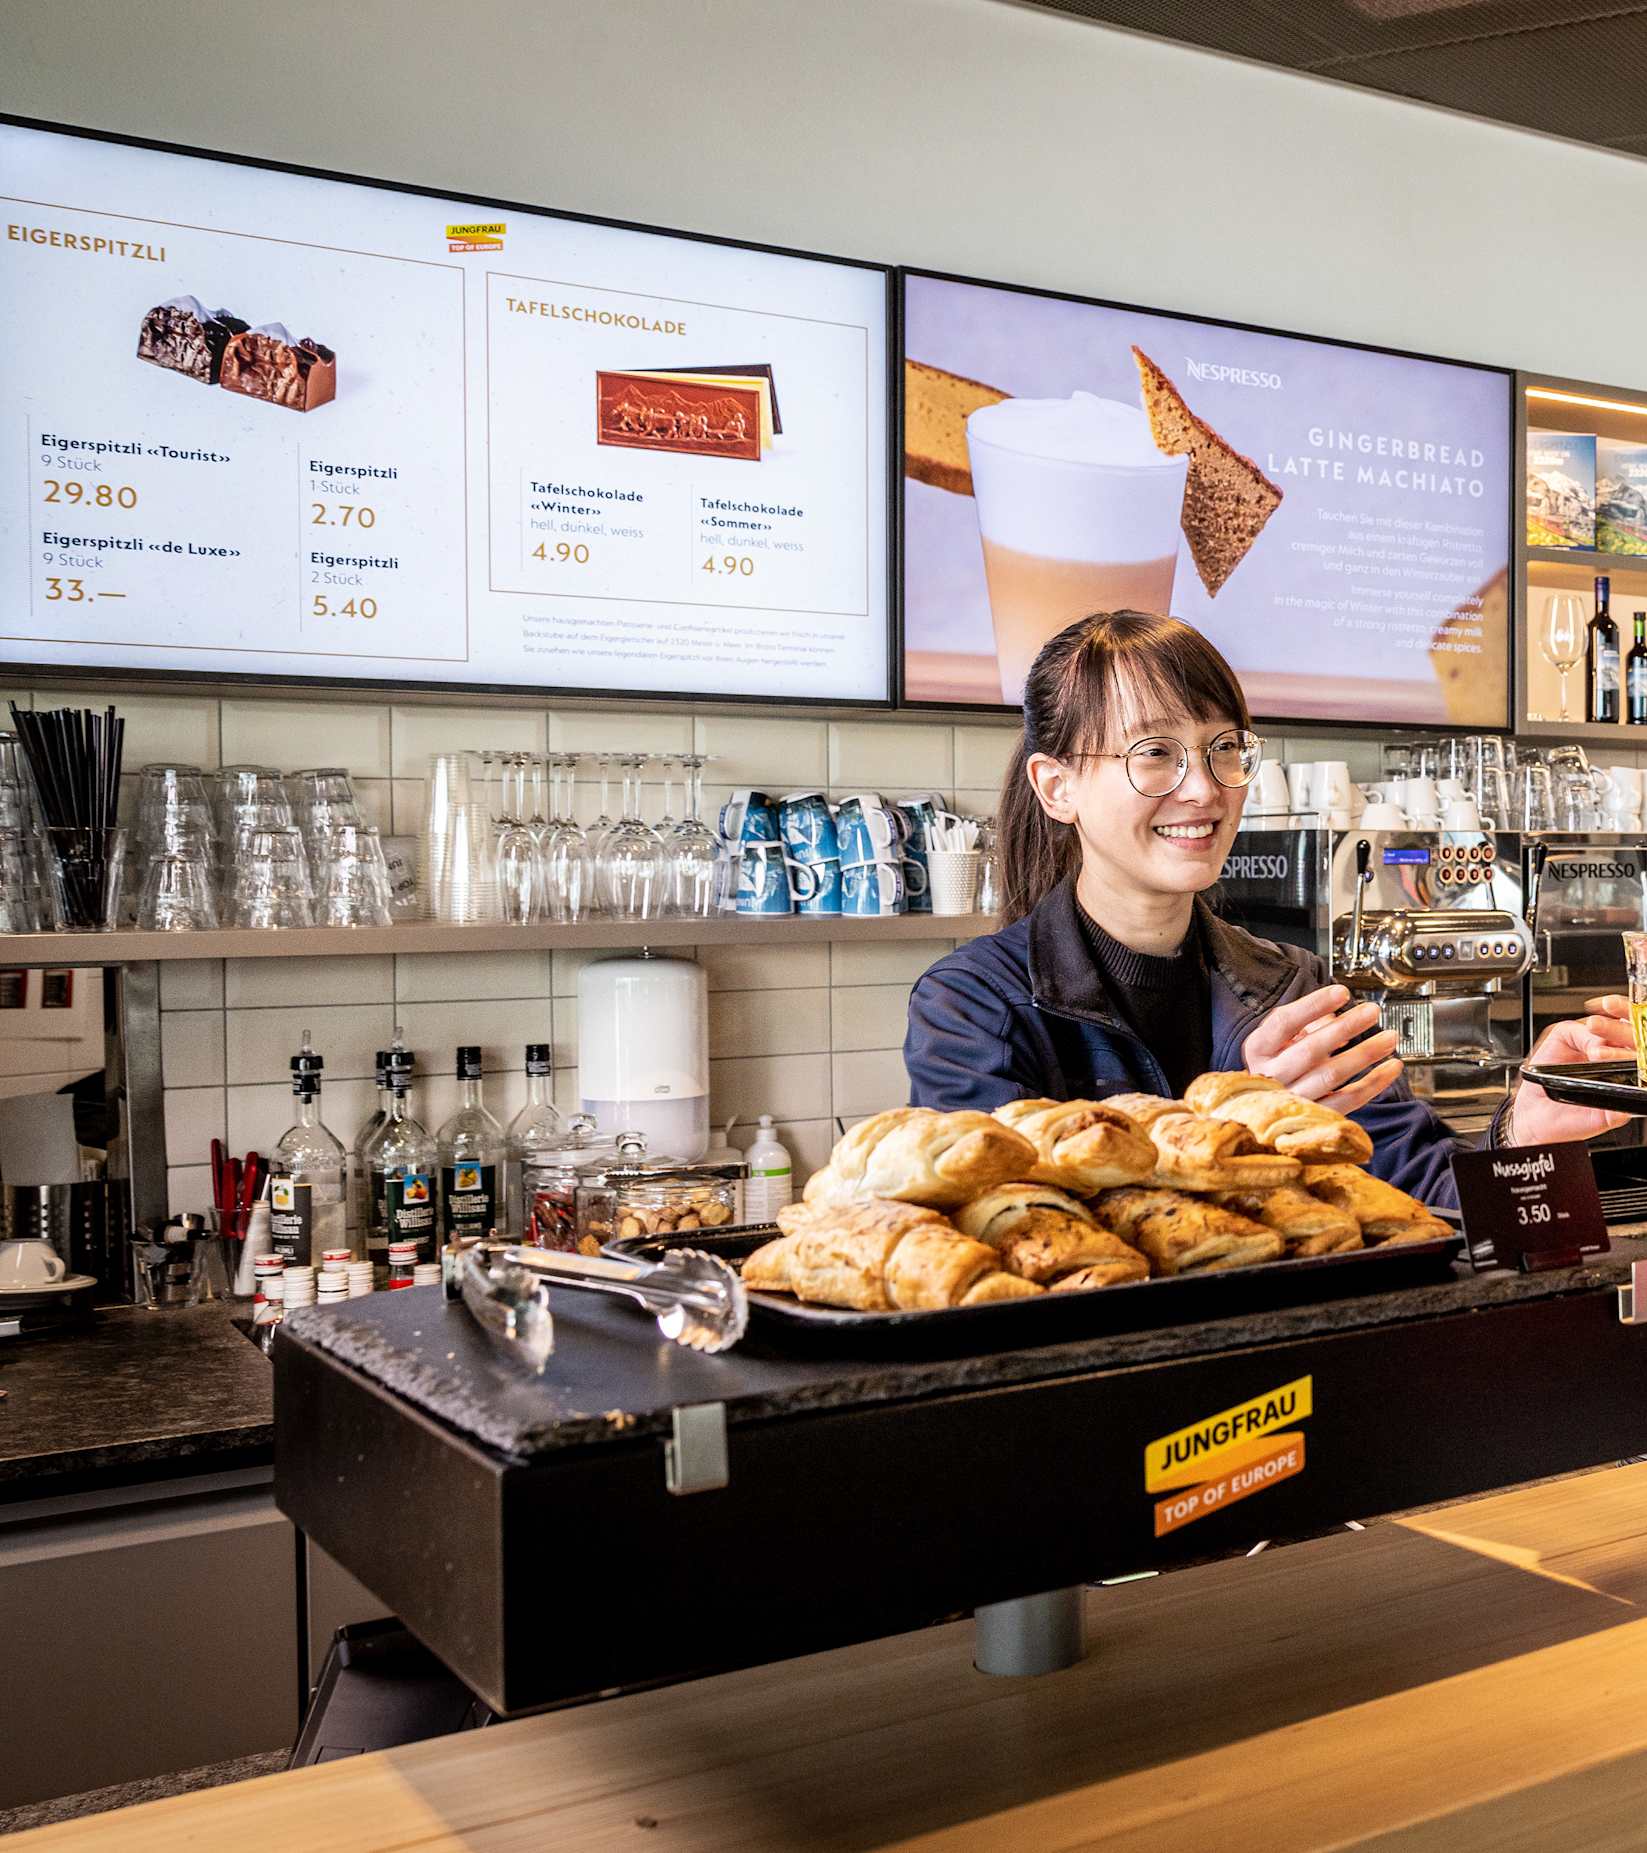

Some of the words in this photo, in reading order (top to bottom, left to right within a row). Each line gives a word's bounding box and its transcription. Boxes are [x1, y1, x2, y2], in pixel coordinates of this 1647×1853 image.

[451, 225, 501, 234] JUNGFRAU
[7, 224, 167, 263] EIGERSPITZLI
[506, 297, 687, 337] TAFELSCHOKOLADE
[1184, 357, 1281, 390] NESPRESSO
[41, 434, 142, 457] Eigerspitzli
[147, 444, 231, 463] «Tourist»
[1308, 427, 1485, 468] GINGERBREAD
[41, 454, 51, 468] 9
[58, 454, 102, 473] Stück
[309, 460, 399, 482] Eigerspitzli
[1268, 454, 1345, 480] LATTE
[1358, 465, 1484, 498] MACHIATO
[42, 479, 138, 510] 29.80
[320, 479, 361, 497] Stück
[530, 481, 644, 503] Tafelschokolade
[311, 503, 376, 529] 2.70
[531, 501, 601, 517] «Winter»
[701, 498, 804, 519] Tafelschokolade
[1360, 512, 1375, 525] Sie
[530, 517, 555, 533] hell,
[561, 519, 607, 537] dunkel,
[610, 526, 644, 539] weiss
[701, 516, 772, 532] «Sommer»
[42, 531, 144, 555] Eigerspitzli
[149, 540, 183, 555] «de
[187, 541, 241, 558] Luxe»
[531, 541, 590, 565] 4.90
[701, 532, 724, 547] hell,
[728, 535, 770, 551] dunkel,
[773, 540, 804, 553] weiss
[43, 552, 53, 566] 9
[59, 552, 103, 570] Stück
[310, 551, 400, 573] Eigerspitzli
[702, 556, 754, 577] 4.90
[311, 571, 319, 584] 2
[325, 570, 363, 587] Stück
[312, 595, 378, 619] 5.40
[1286, 595, 1302, 608] the
[1304, 597, 1335, 613] magic
[1219, 854, 1288, 880] SPRESSO
[1548, 861, 1636, 882] NESPRESSO
[1492, 1152, 1555, 1181] Nussgipfel
[1517, 1203, 1551, 1225] 3.50
[1161, 1391, 1296, 1470] JUNGFRAU
[1164, 1496, 1199, 1524] TOP
[1203, 1482, 1227, 1505] OF
[1232, 1450, 1297, 1493] EUROPE
